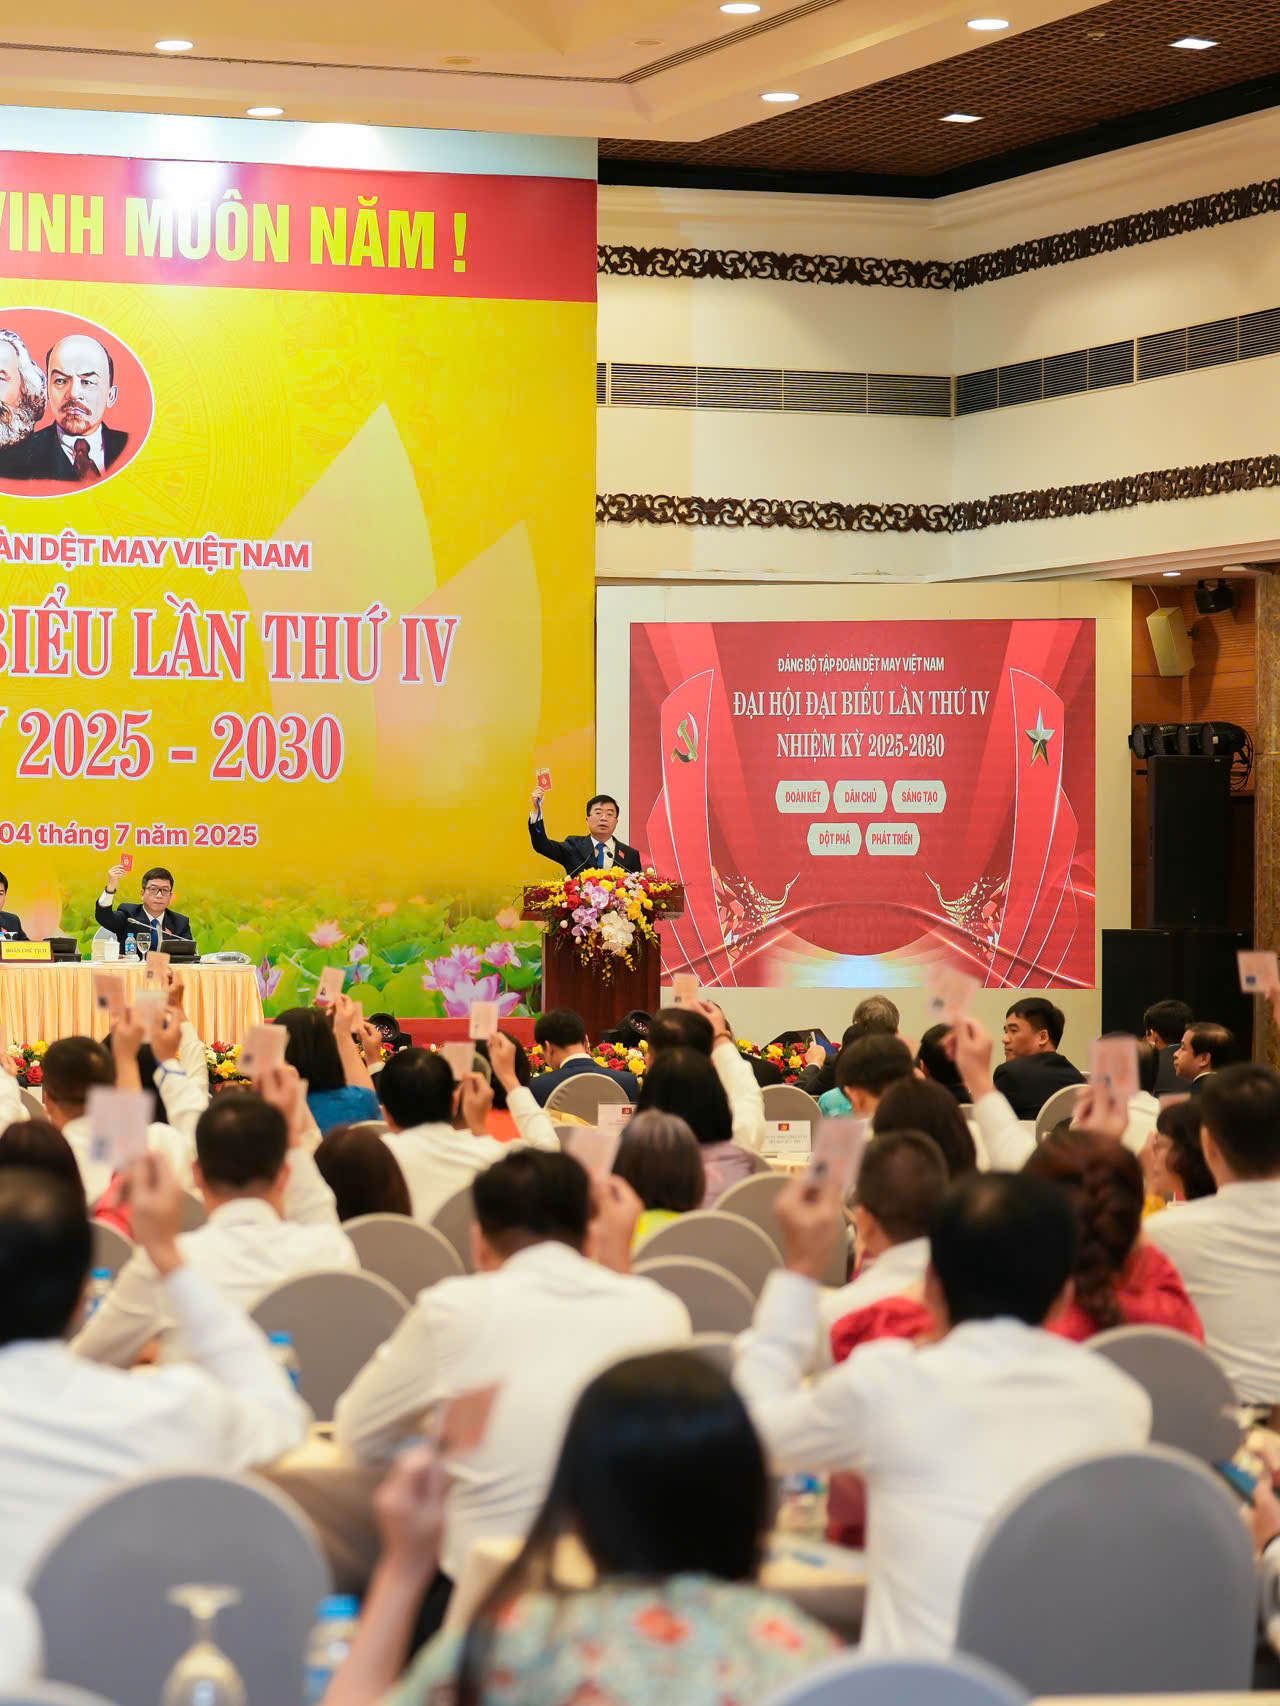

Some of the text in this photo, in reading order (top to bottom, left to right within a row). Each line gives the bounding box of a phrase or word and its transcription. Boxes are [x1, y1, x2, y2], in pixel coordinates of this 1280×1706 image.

[124, 188, 290, 263] MUÔN
[309, 195, 436, 271] NĂM
[452, 212, 468, 273] !
[39, 530, 97, 569] DỆT
[101, 538, 169, 565] MAY
[173, 534, 238, 573] VIỆT
[242, 543, 310, 569] NAM
[132, 592, 248, 680] LẦN
[263, 603, 389, 682] THỨ
[400, 616, 460, 684] IV
[777, 653, 945, 676] ĐẢNG BỘ TẬP ĐOÀN DỆT MAY VIỆT NAM
[733, 691, 765, 720] ĐẠI
[768, 686, 802, 722] HỘI
[805, 691, 837, 720] ĐẠI
[888, 684, 925, 716] LẦN
[928, 686, 968, 716] THỨ
[970, 690, 991, 716] IV
[18, 709, 152, 778] 2025
[171, 749, 194, 761] -
[211, 714, 342, 781] 2030
[776, 728, 946, 763] NHIỆM KỲ 2025-2030
[844, 788, 860, 803] DÂN
[901, 788, 938, 806] SÁNG TẠO
[38, 822, 110, 850] tháng
[115, 824, 130, 846] 7
[135, 824, 188, 846] năm
[194, 824, 258, 847] 2025
[818, 829, 835, 848] ĐỘT
[871, 830, 891, 845] PHÁT
